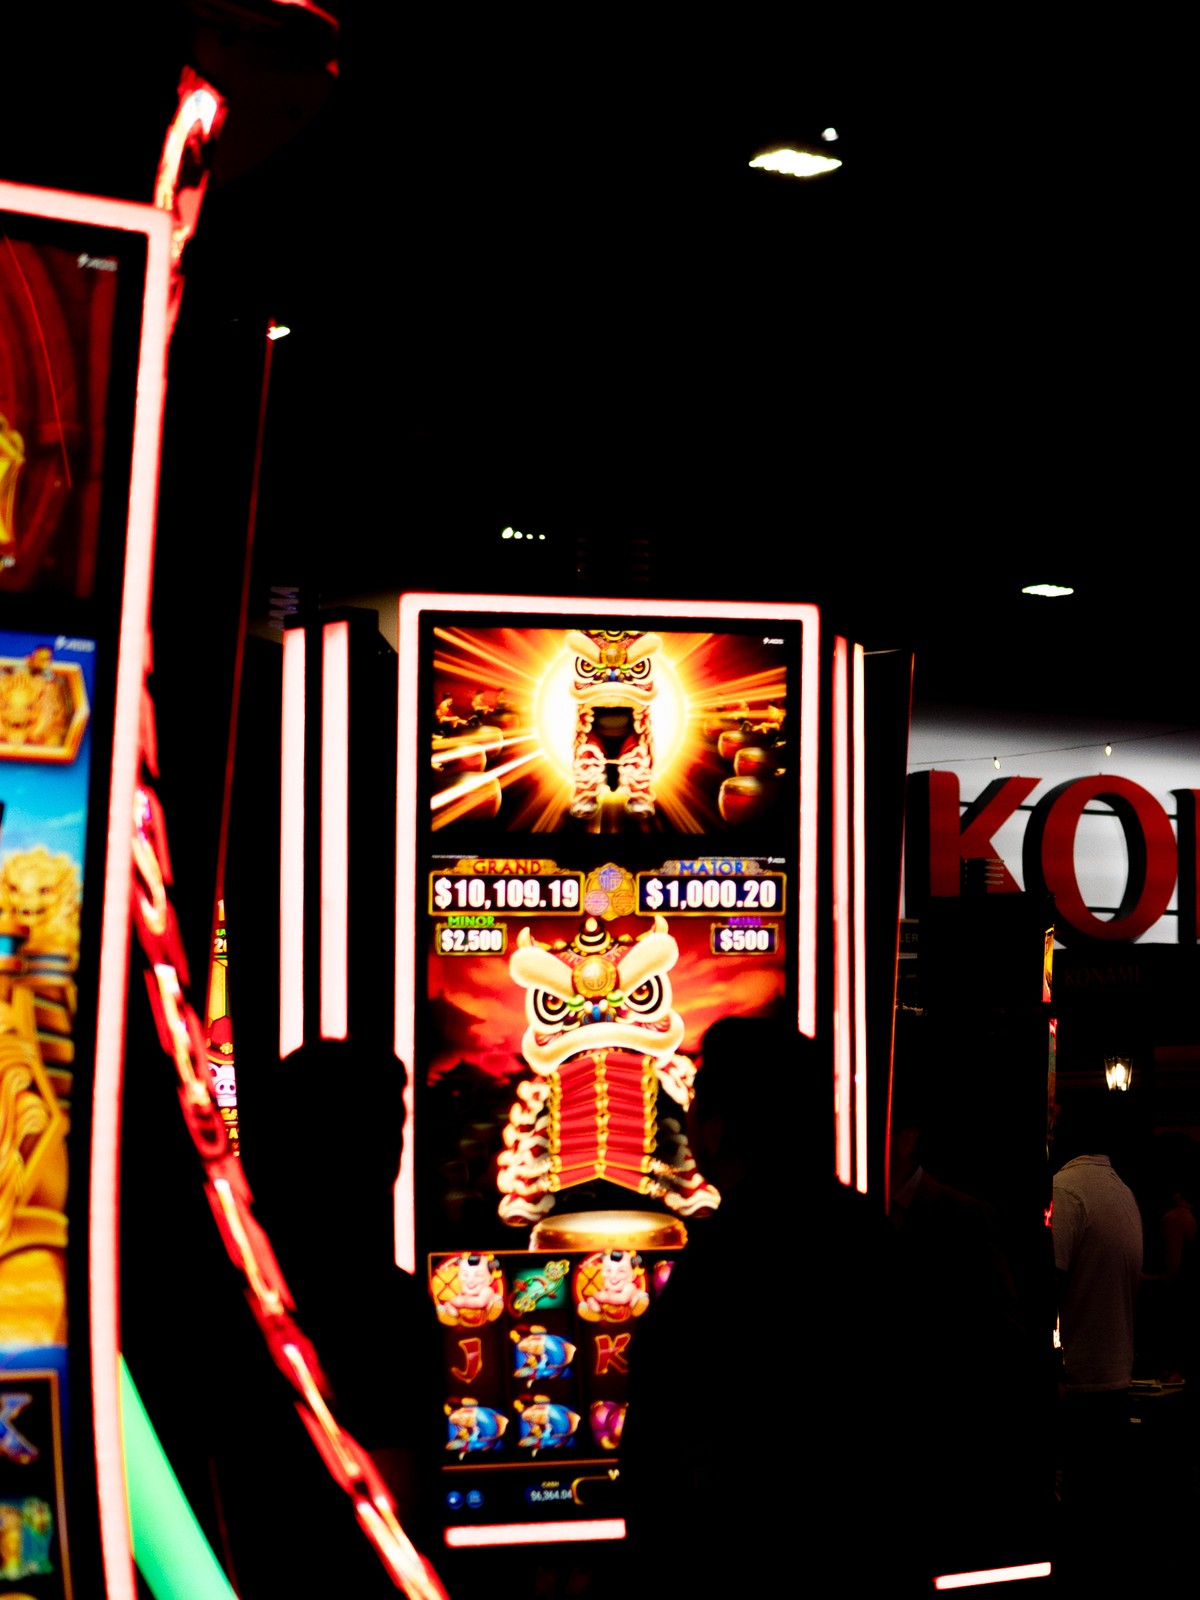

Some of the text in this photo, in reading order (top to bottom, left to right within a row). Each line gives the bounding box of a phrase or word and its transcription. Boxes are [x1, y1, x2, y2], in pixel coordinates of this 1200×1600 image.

[473, 860, 542, 875] GRAND
[679, 860, 743, 876] MAJOR
[434, 877, 580, 912] $10,109.19
[646, 877, 777, 911] $1,000.20
[447, 916, 495, 928] MINOR
[441, 929, 503, 952] $2,500
[719, 929, 770, 952] $500
[1063, 964, 1142, 988] KONAMI
